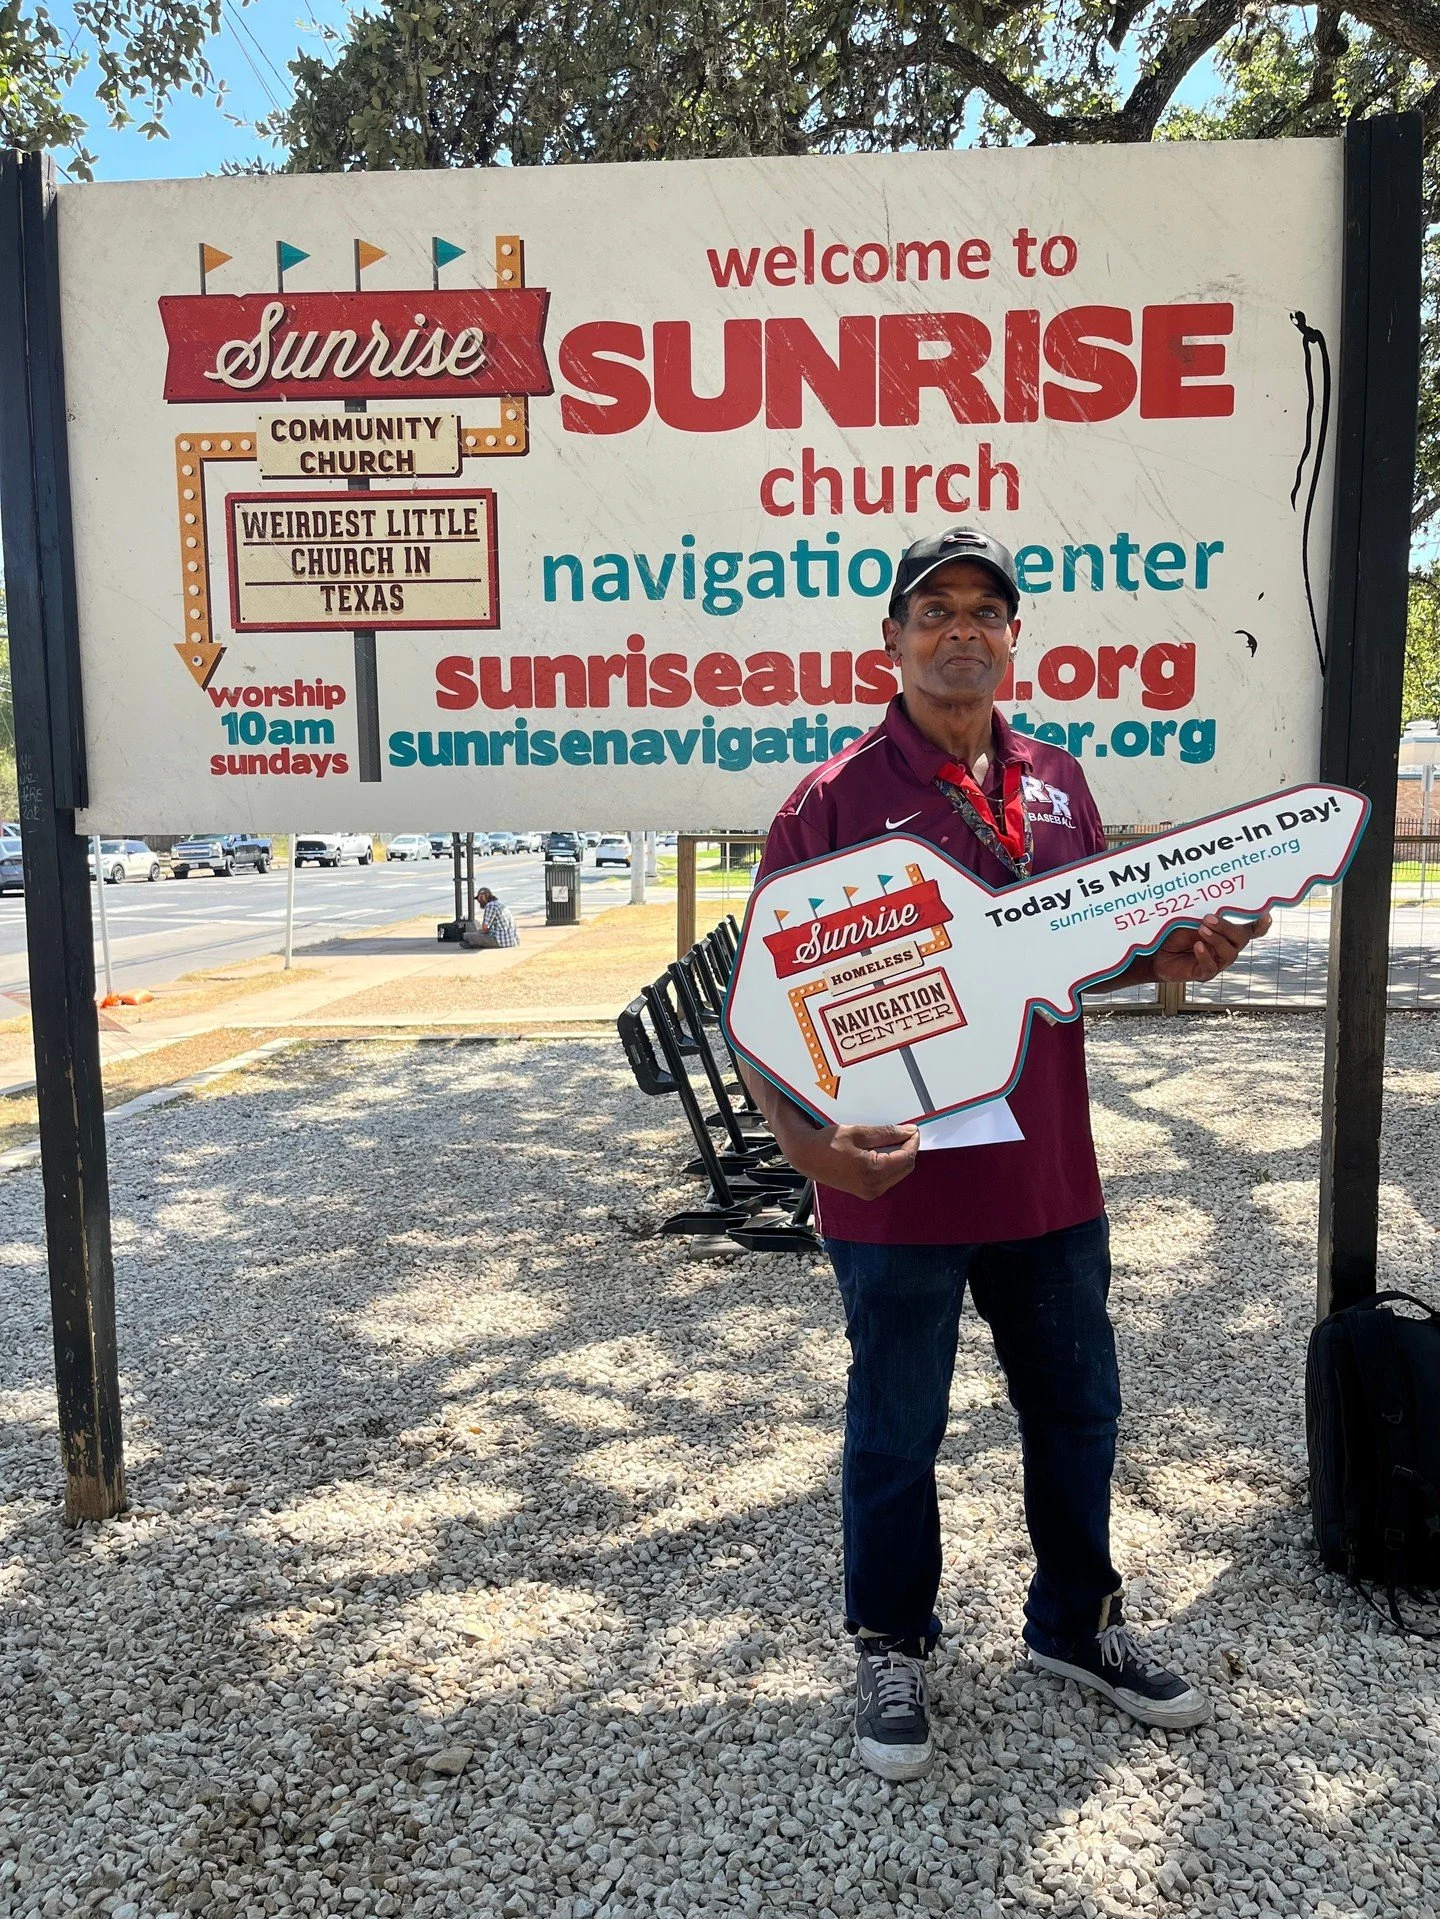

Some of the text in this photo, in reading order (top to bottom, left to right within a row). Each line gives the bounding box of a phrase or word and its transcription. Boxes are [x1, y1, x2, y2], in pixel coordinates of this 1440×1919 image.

[707, 227, 1078, 288] welcome to
[203, 301, 488, 389] Sunrise
[558, 302, 1235, 435] SUNRISE
[270, 416, 442, 442] COMMUNITY
[299, 450, 414, 474] CHURCH
[760, 442, 1019, 517] church
[242, 508, 478, 538] WEIRDEST LITTLE
[291, 546, 431, 575] CHURCH IN
[543, 531, 1225, 616] navigatio enter
[320, 584, 405, 612] TEXAS
[208, 678, 346, 709] worship
[436, 634, 1197, 712] sunriseaus.org
[222, 712, 335, 746] 10am
[210, 747, 349, 778] sundays
[984, 795, 1342, 928] Today is My Move-In Day!
[1049, 838, 1301, 932] sunrisenavigationcenter.org
[1114, 874, 1245, 931] 512-522-1097
[792, 903, 919, 964] Sunrise
[830, 950, 914, 986] HOMELESS
[831, 982, 946, 1036] NAVIGATION
[840, 1003, 954, 1050] CENTER
